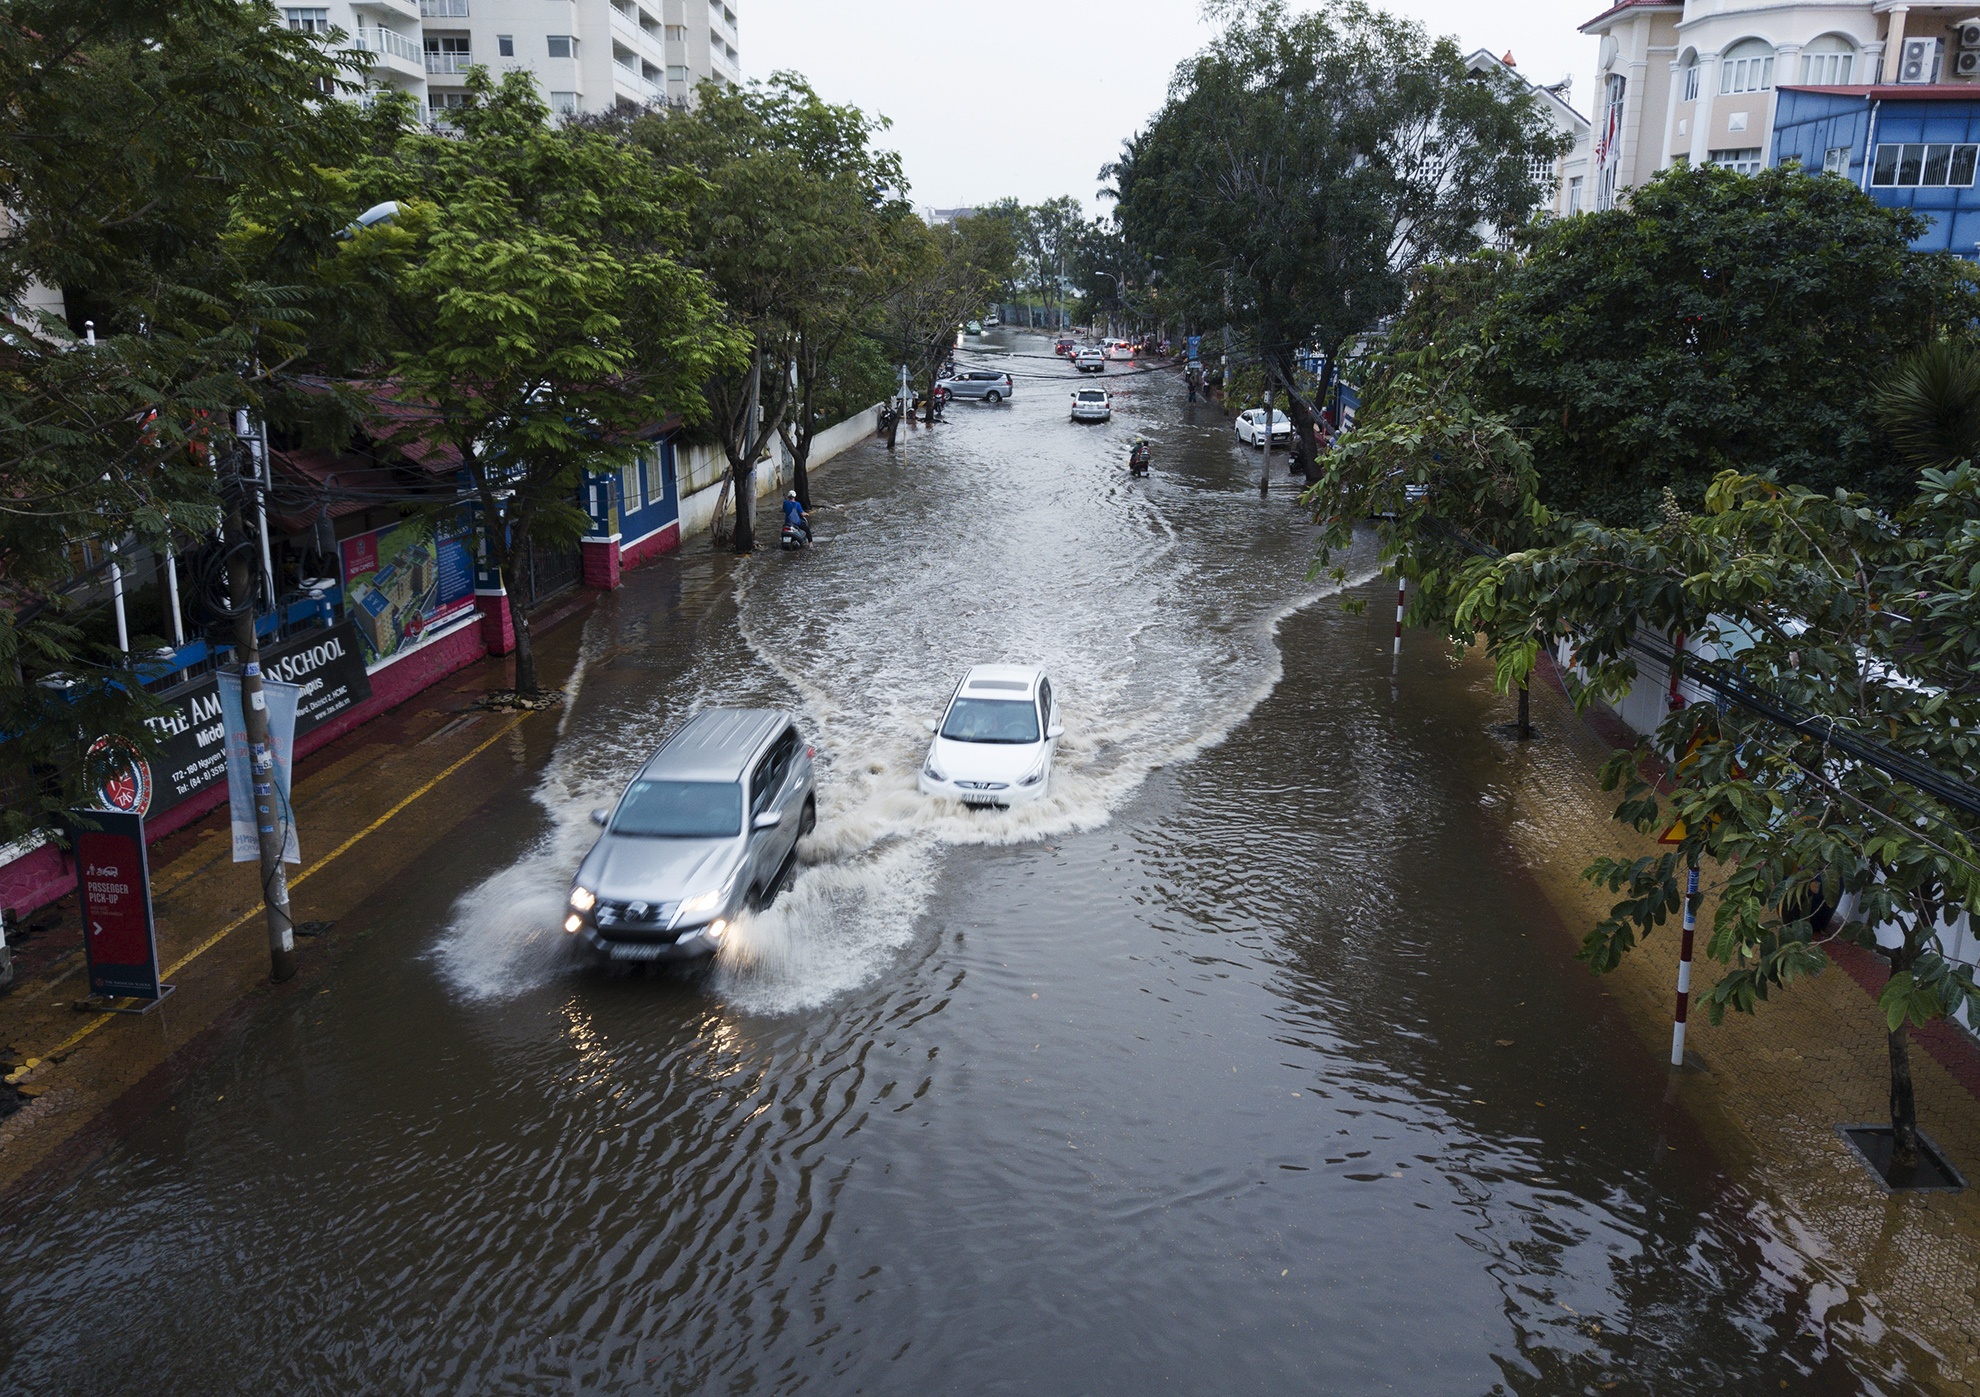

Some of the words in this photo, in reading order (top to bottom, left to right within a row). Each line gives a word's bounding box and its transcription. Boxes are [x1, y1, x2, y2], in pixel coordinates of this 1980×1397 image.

[143, 707, 190, 744] THE
[281, 637, 346, 681] SCHOOL
[197, 752, 221, 771] Nguyen
[309, 696, 327, 711] District
[176, 782, 190, 795] Tel:
[117, 791, 133, 807] TAS
[87, 881, 129, 894] PASSENGER
[88, 893, 119, 904] PICK-UP
